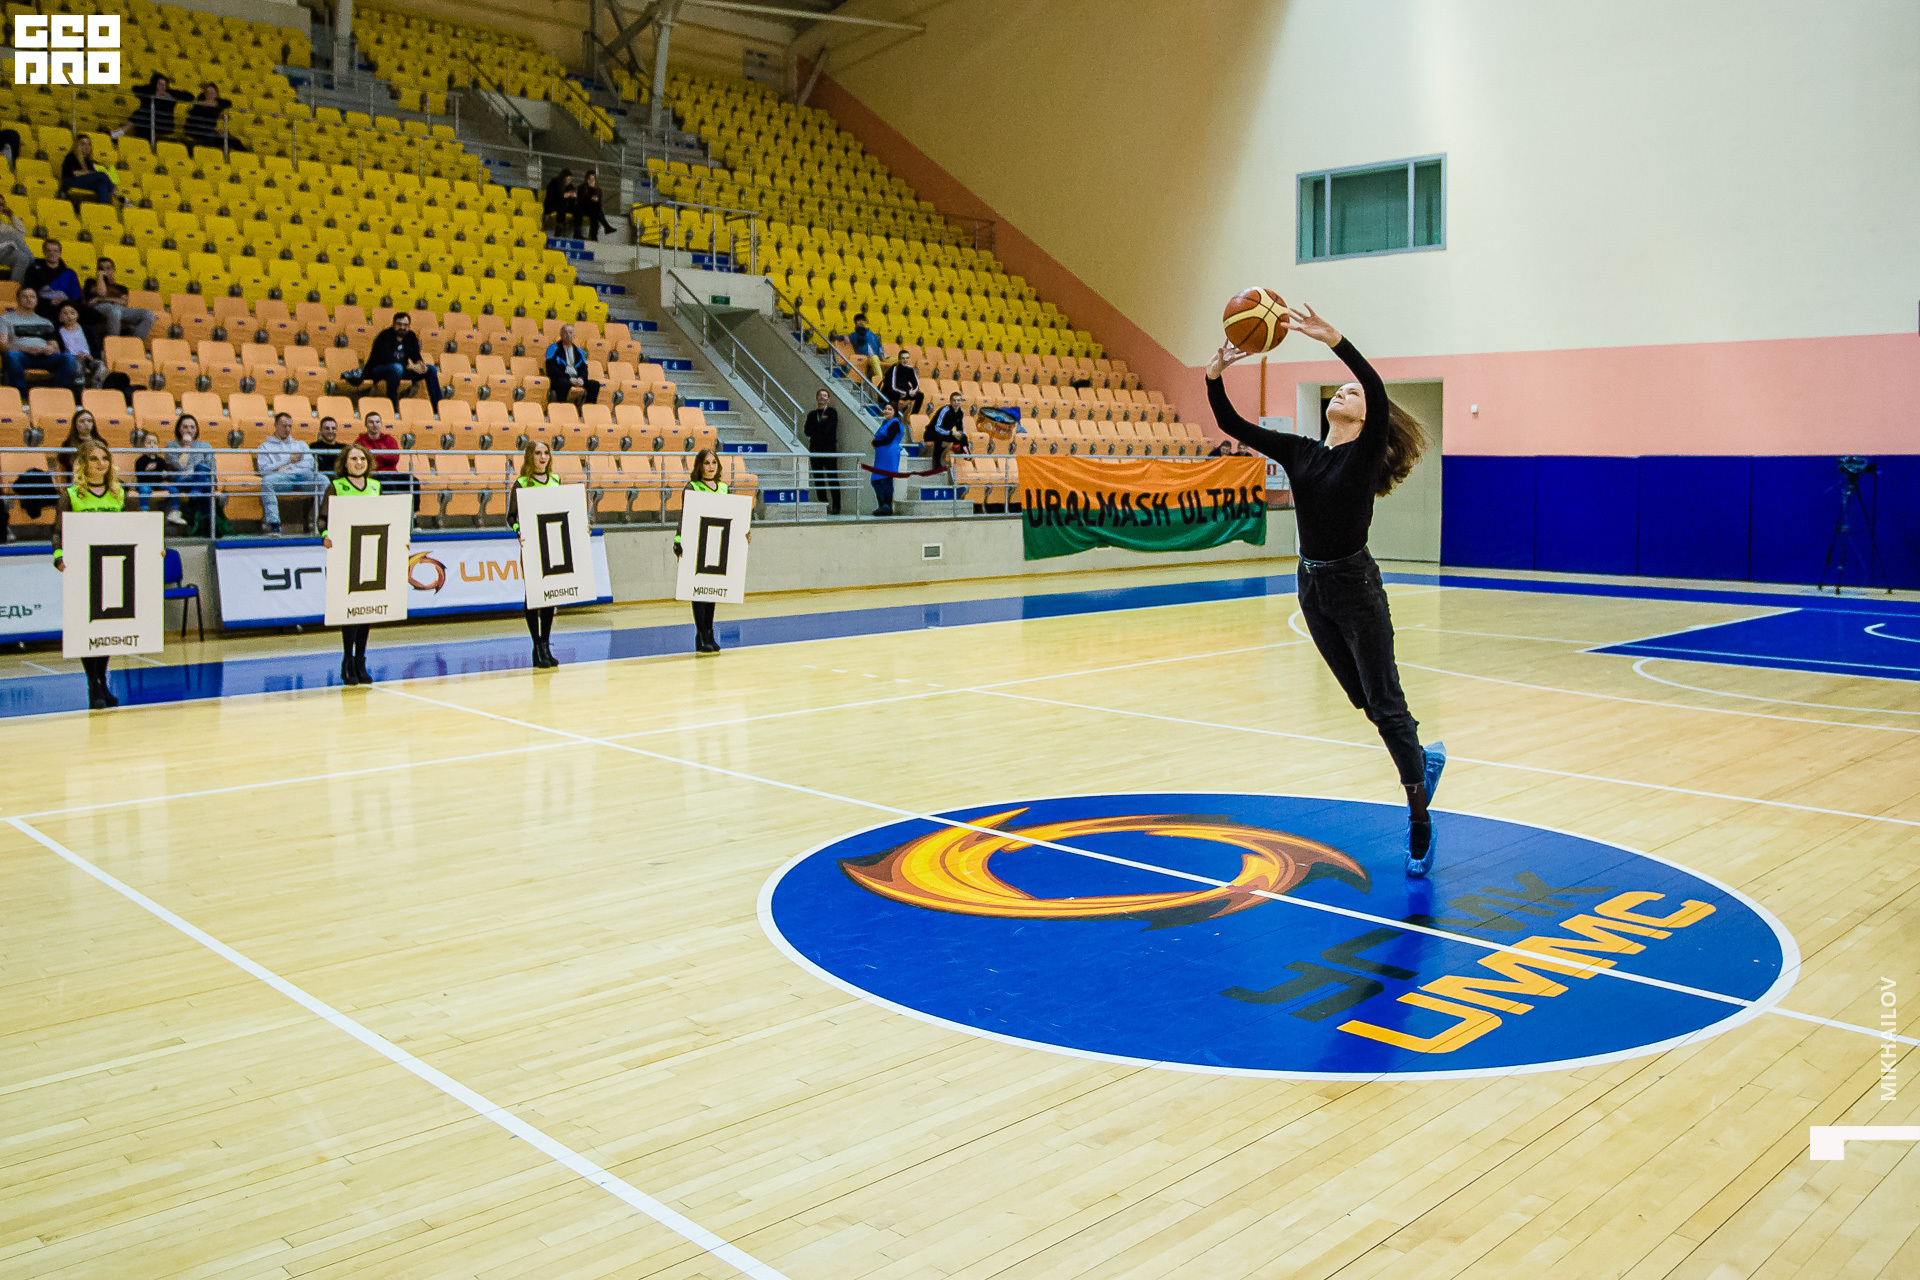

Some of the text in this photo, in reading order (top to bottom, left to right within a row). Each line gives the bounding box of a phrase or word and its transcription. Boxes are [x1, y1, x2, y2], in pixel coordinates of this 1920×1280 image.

[1025, 485, 1266, 528] URALMASH ULTRAS
[261, 566, 327, 592] УГ
[459, 560, 524, 582] UM
[543, 586, 579, 601] MADSHOT
[693, 586, 728, 599] MADSHOT
[346, 604, 389, 618] MADSHOT
[89, 635, 140, 650] MADSHOT
[1336, 891, 1717, 1054] UMMC
